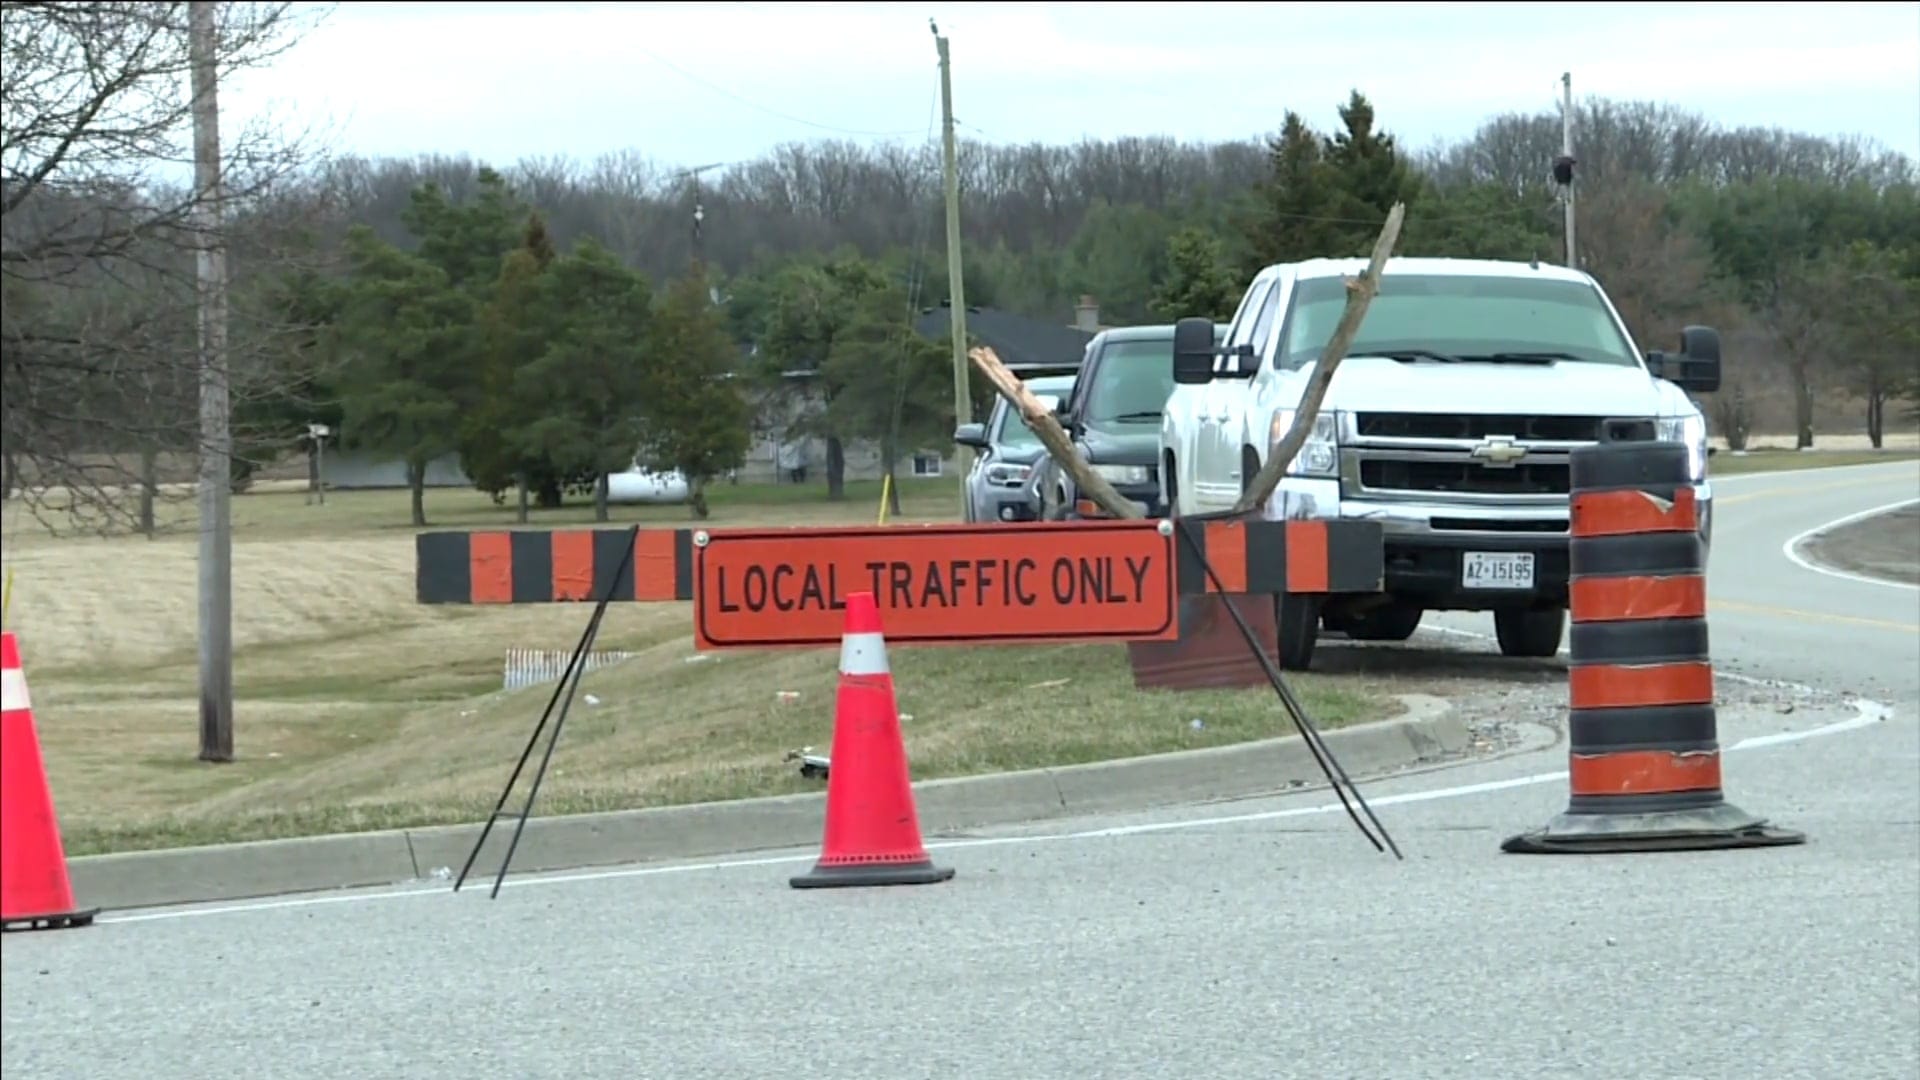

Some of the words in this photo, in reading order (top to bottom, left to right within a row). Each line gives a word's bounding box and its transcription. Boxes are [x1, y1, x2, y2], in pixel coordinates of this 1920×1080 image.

[717, 562, 847, 613] LOCAL
[865, 557, 1037, 609] TRAFFIC
[1051, 555, 1152, 606] ONLY
